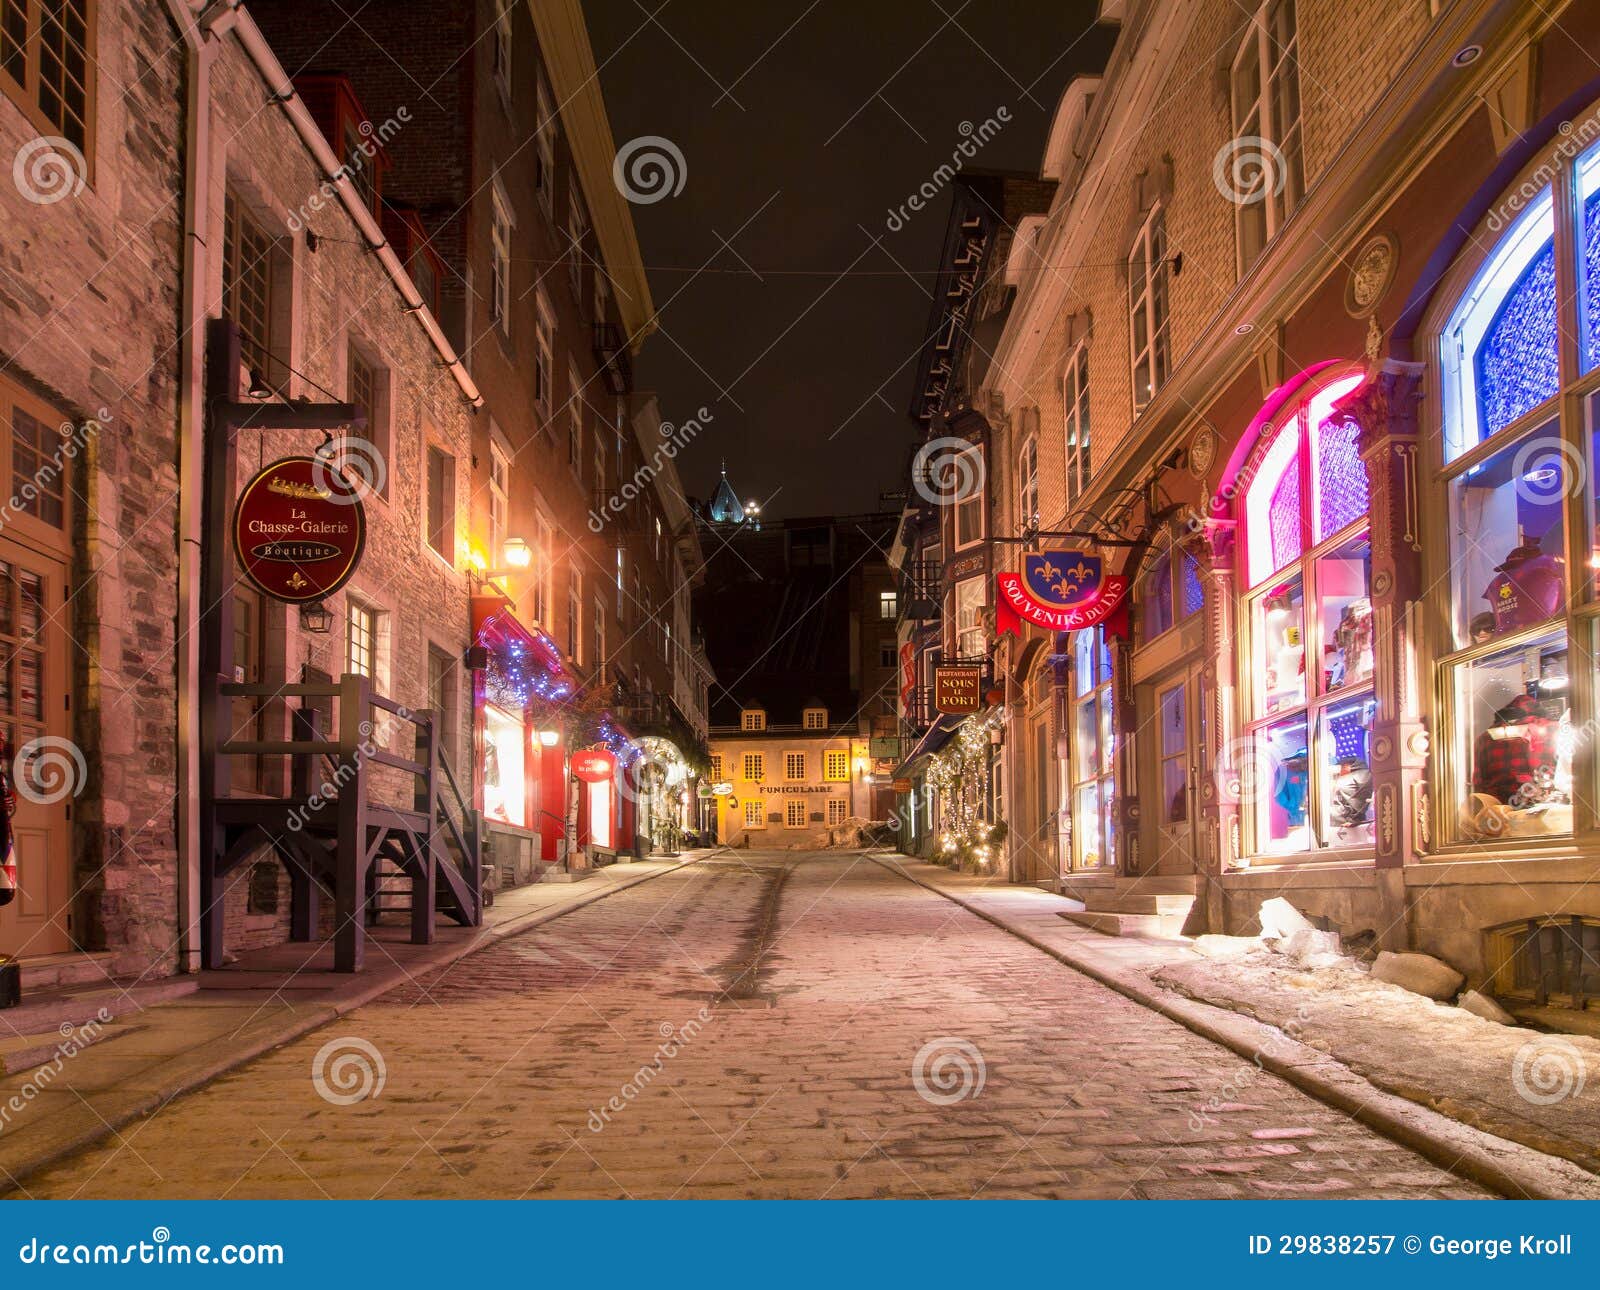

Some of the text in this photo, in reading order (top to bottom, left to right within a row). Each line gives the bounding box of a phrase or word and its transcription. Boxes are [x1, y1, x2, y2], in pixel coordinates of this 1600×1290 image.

[291, 508, 306, 519] La
[248, 520, 349, 533] Chasse-Galerie
[264, 546, 330, 558] Boutique
[1003, 579, 1122, 626] SOUVENIRS DU LYS
[942, 679, 974, 688] SOUS
[940, 696, 977, 705] FORT
[759, 786, 833, 794] FUNICULAIRE
